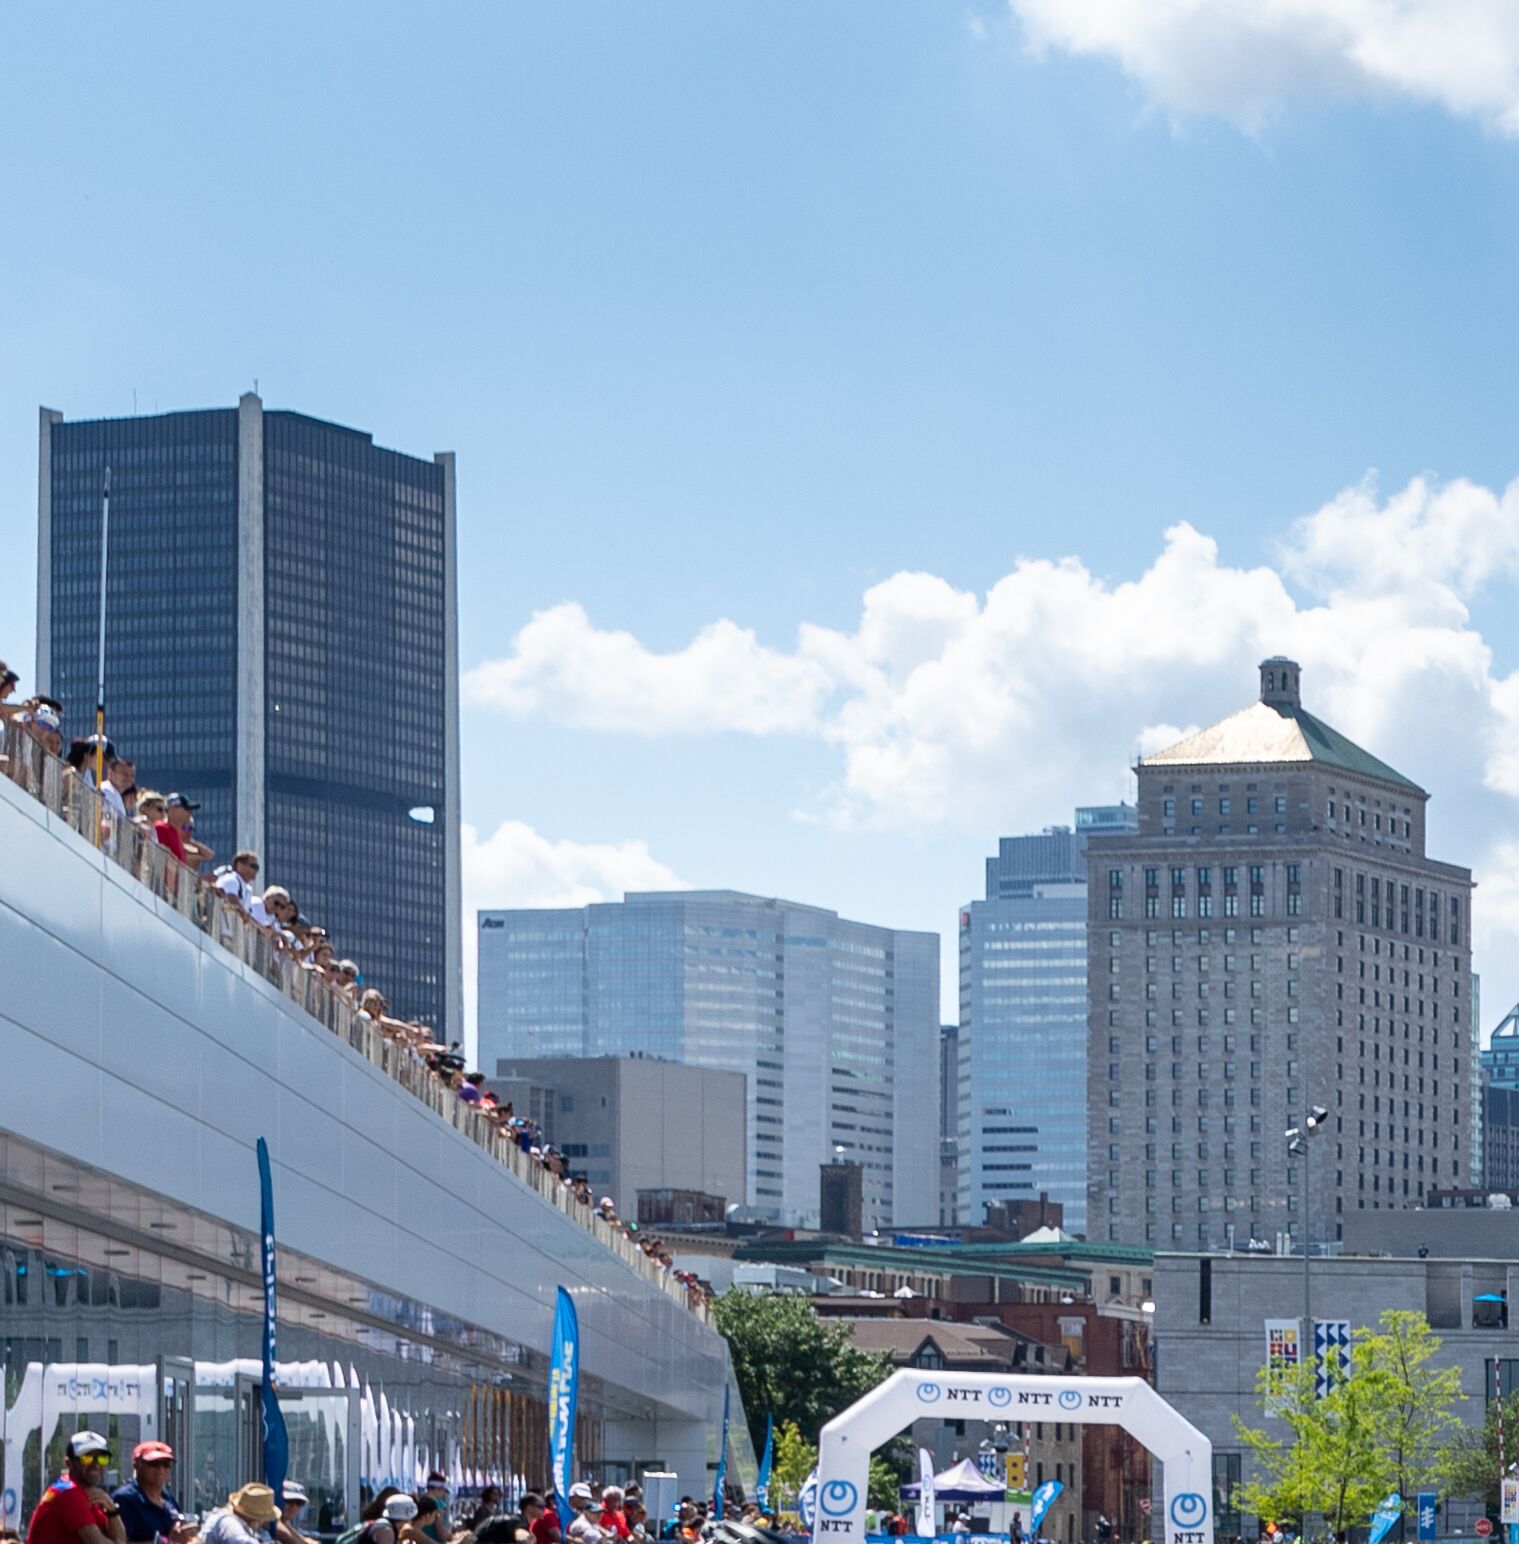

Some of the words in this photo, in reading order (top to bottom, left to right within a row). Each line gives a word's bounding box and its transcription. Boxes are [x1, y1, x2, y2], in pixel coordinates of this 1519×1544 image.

[947, 1389, 983, 1401] NTT
[1018, 1392, 1053, 1405] NTT
[1088, 1396, 1123, 1408] NTT
[820, 1520, 853, 1532] NTT
[1174, 1533, 1205, 1544] NTT
